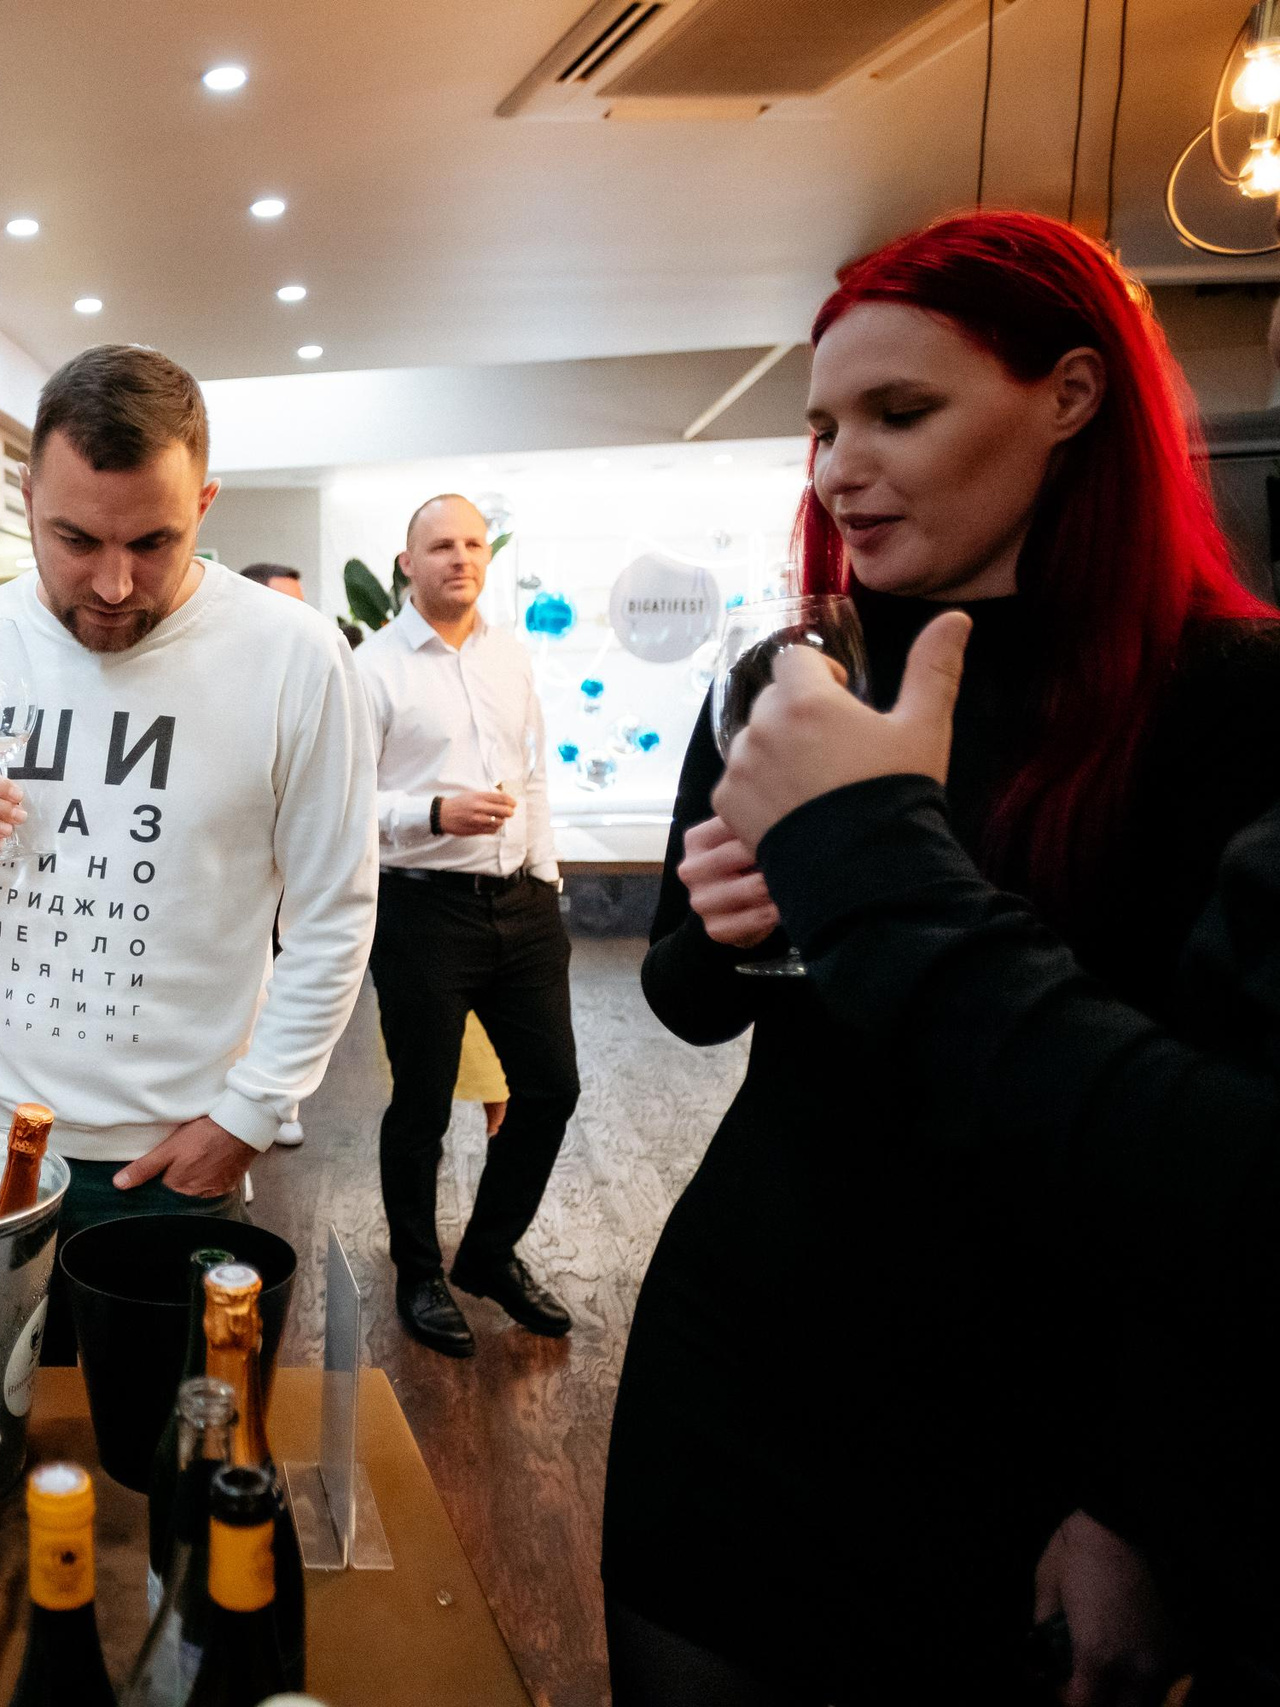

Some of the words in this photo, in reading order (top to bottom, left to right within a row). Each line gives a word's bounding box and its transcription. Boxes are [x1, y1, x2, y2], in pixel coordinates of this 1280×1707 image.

[0, 704, 176, 790] ШИ
[58, 798, 162, 843] АЗ
[2, 853, 155, 884] ИНО
